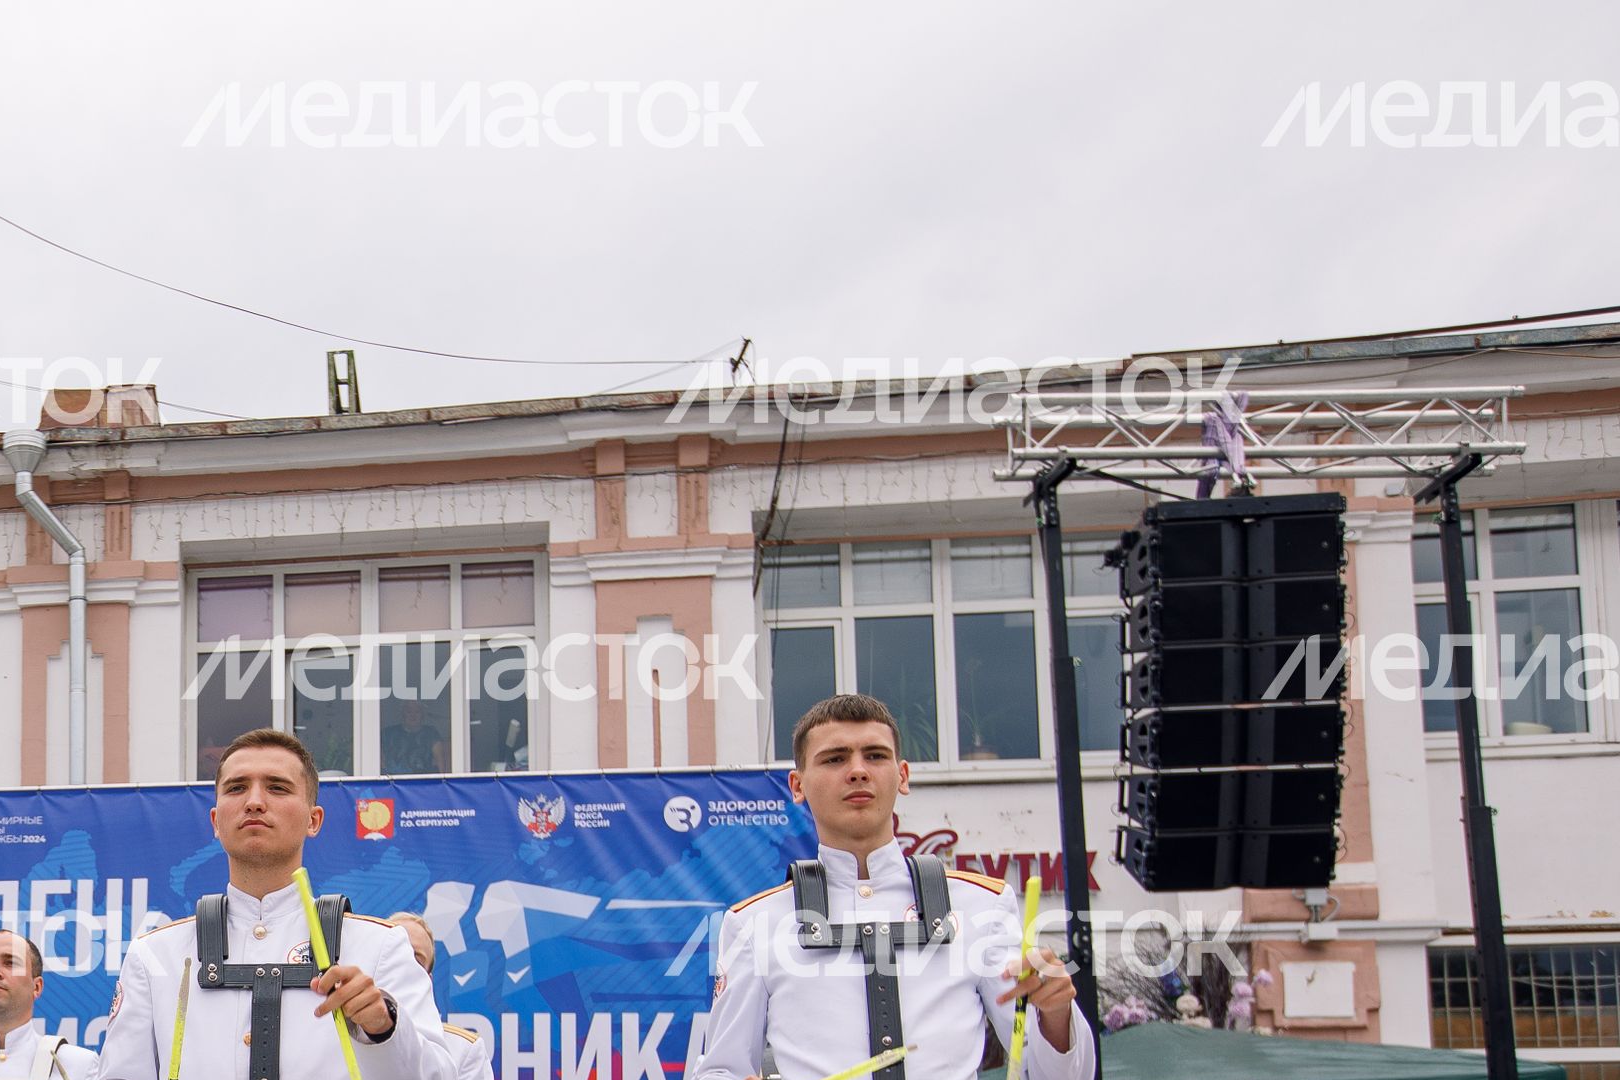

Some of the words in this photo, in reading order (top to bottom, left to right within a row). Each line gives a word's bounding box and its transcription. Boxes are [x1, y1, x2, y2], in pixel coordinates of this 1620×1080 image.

[574, 802, 626, 812] ФЕДЕРАЦИЯ
[708, 799, 786, 813] ЗДОРОВОЕ
[400, 809, 476, 819] АДМИНИСТРАЦИЯ
[574, 811, 604, 820] БОКСА
[415, 819, 460, 827] СЕРПУХОВ
[574, 819, 611, 828] РОССИИ
[708, 813, 789, 827] ОТЕЧЕСТВО
[23, 834, 47, 844] 2024
